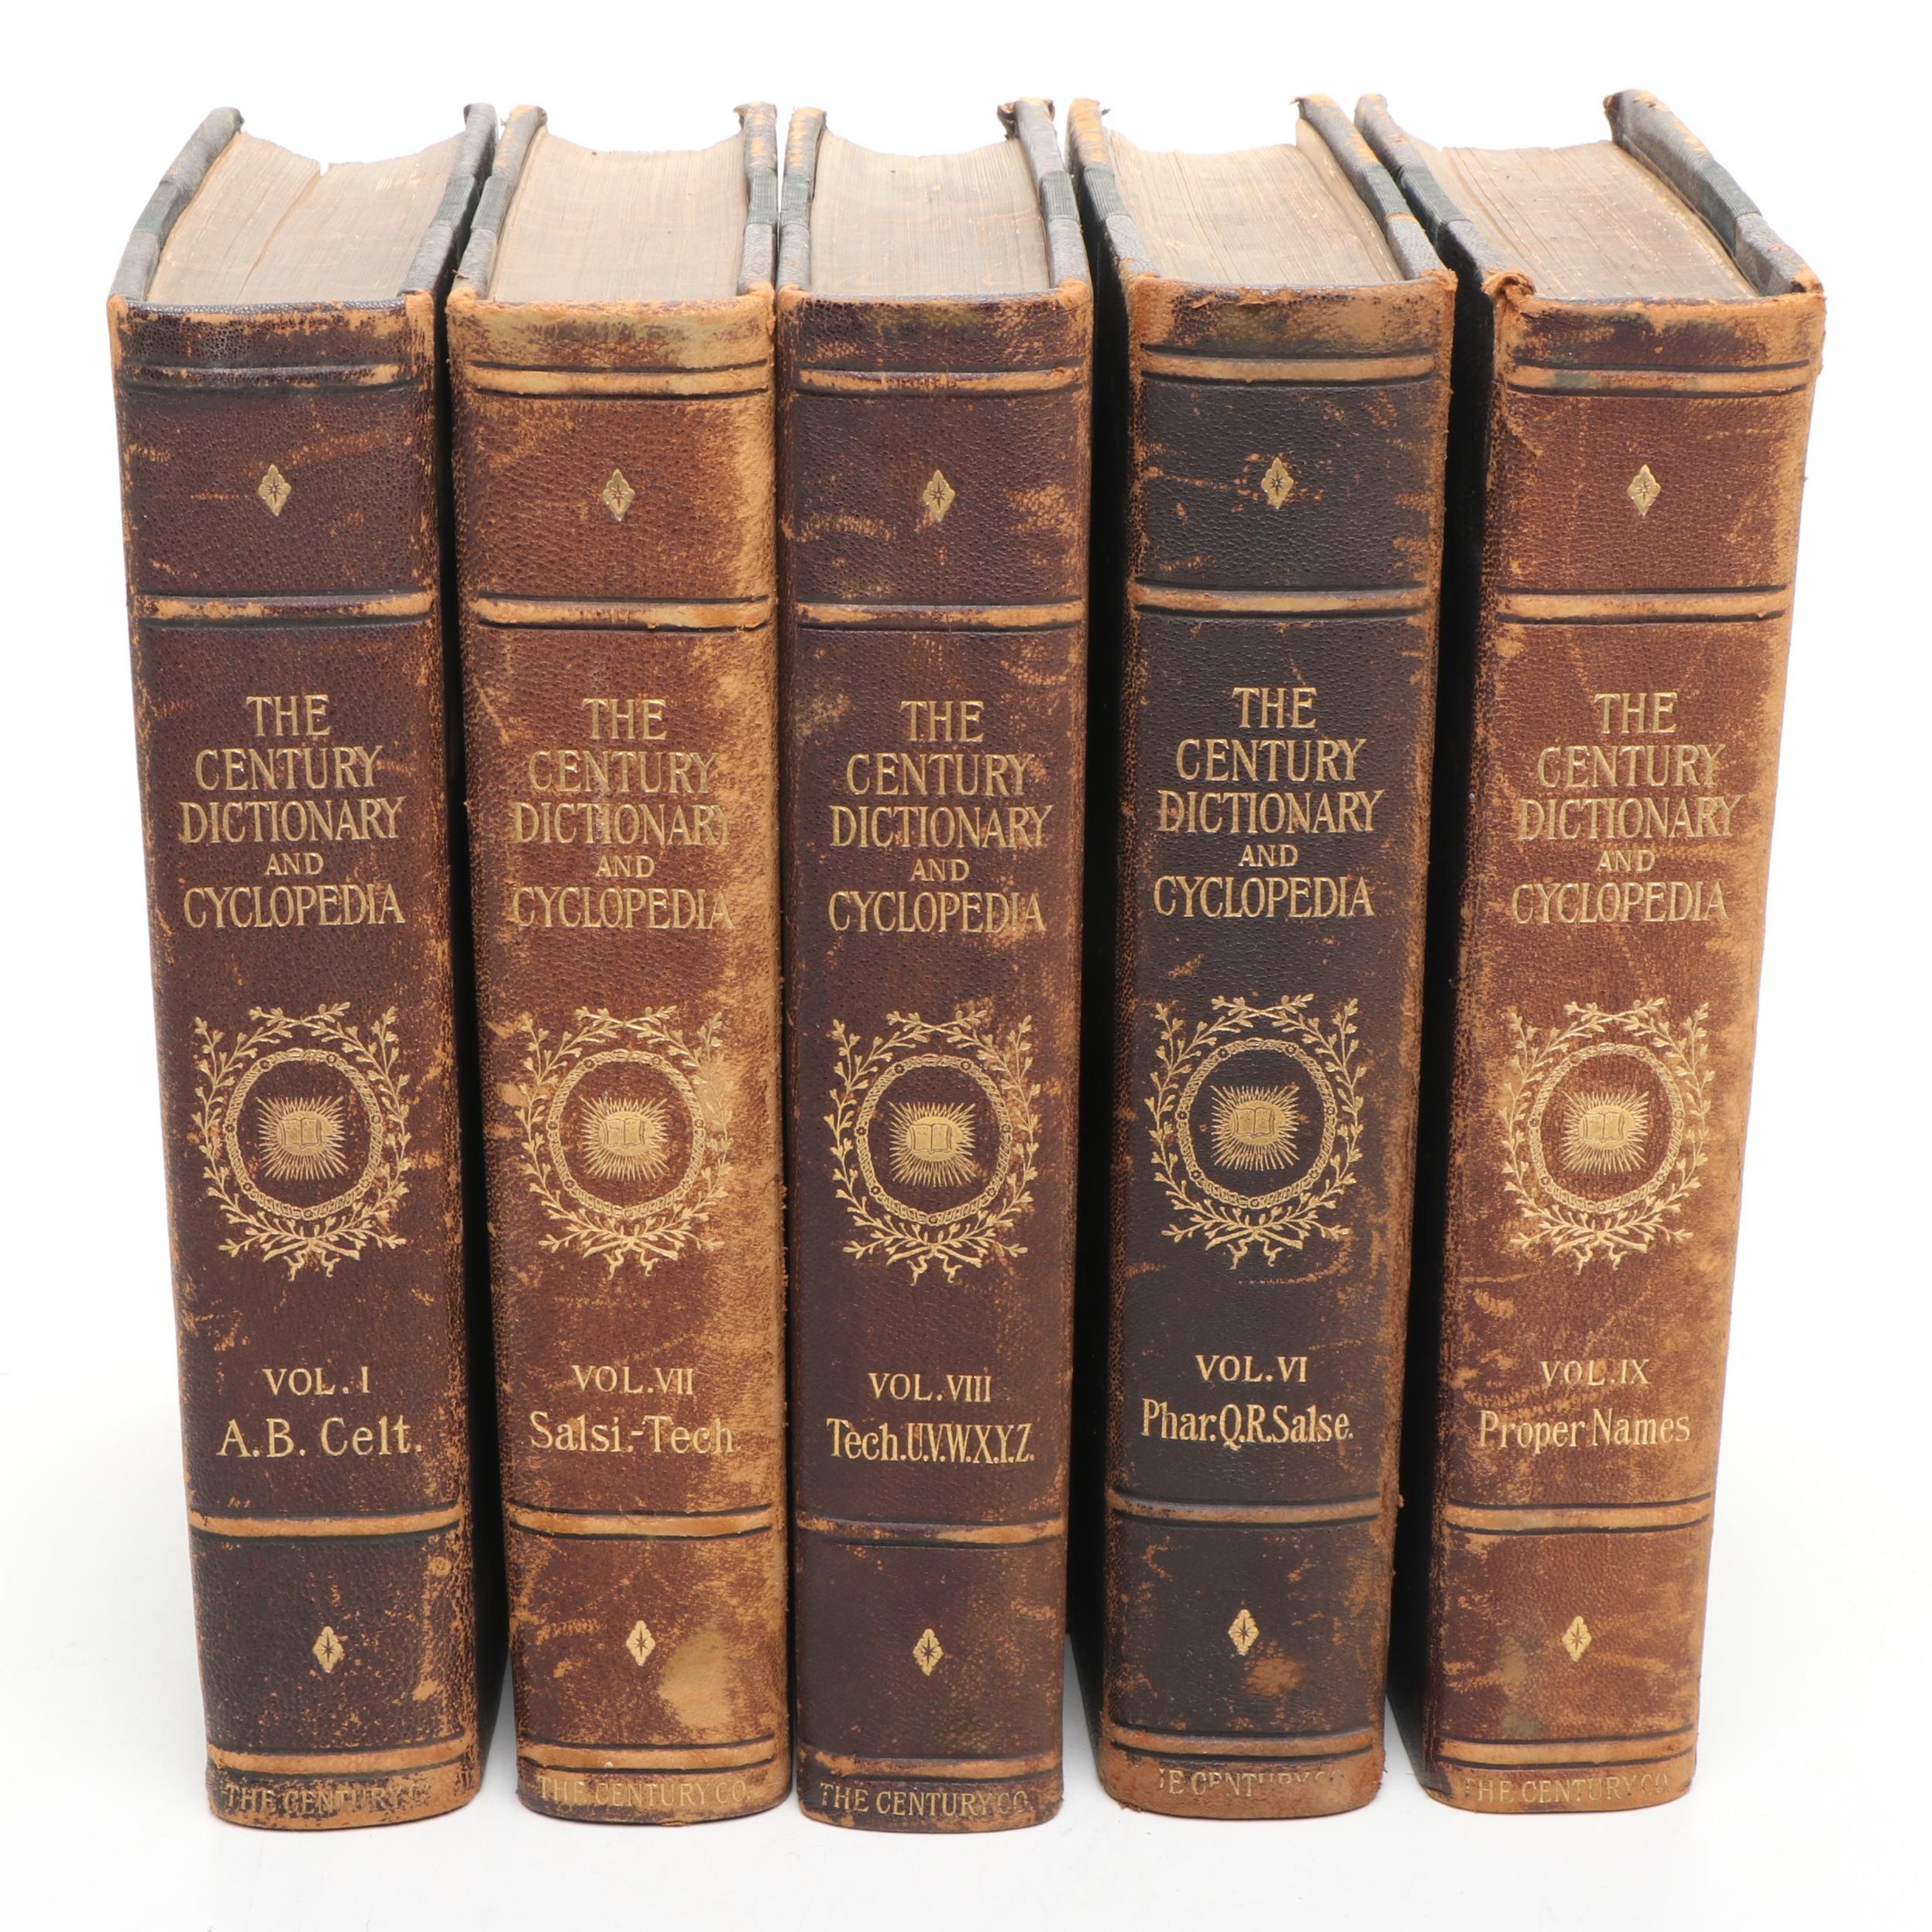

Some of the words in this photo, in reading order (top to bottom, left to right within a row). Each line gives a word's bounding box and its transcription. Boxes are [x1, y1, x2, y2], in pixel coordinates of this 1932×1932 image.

[246, 694, 331, 737] THE
[582, 698, 666, 741] THE
[901, 700, 984, 743] THE
[1232, 687, 1317, 729] THE
[1594, 693, 1677, 734] THE
[195, 745, 383, 791] CENTURY
[529, 749, 719, 793] CENTURY
[846, 753, 1034, 796] CENTURY
[1177, 738, 1366, 782] CENTURY
[1538, 744, 1725, 788] CENTURY
[180, 796, 406, 844] DICTIONARY
[513, 801, 731, 846] DICTIONARY
[829, 805, 1054, 848] DICTIONARY
[1157, 789, 1384, 834] DICTIONARY
[1518, 795, 1743, 841] DICTIONARY
[264, 852, 324, 875] AND
[594, 854, 655, 878] AND
[909, 858, 969, 882] AND
[1239, 844, 1298, 868] AND
[1596, 849, 1655, 872] AND
[184, 883, 406, 928] CYCLOPEDIA
[511, 886, 735, 930] CYCLOPEDIA
[828, 892, 1046, 933] CYCLOPEDIA
[1153, 875, 1375, 918] CYCLOPEDIA
[1512, 881, 1728, 923] CYCLOPEDIA
[321, 1415, 422, 1455] Celt.
[1480, 1409, 1586, 1454] Proper
[1592, 1408, 1691, 1447] Names
[226, 1782, 277, 1813] THE
[535, 1775, 587, 1805] THE
[595, 1781, 711, 1807] CENTURY
[820, 1782, 869, 1813] THE
[876, 1790, 992, 1817] CENTURY
[1465, 1778, 1514, 1803] THE
[1521, 1776, 1637, 1804] CENTURY
